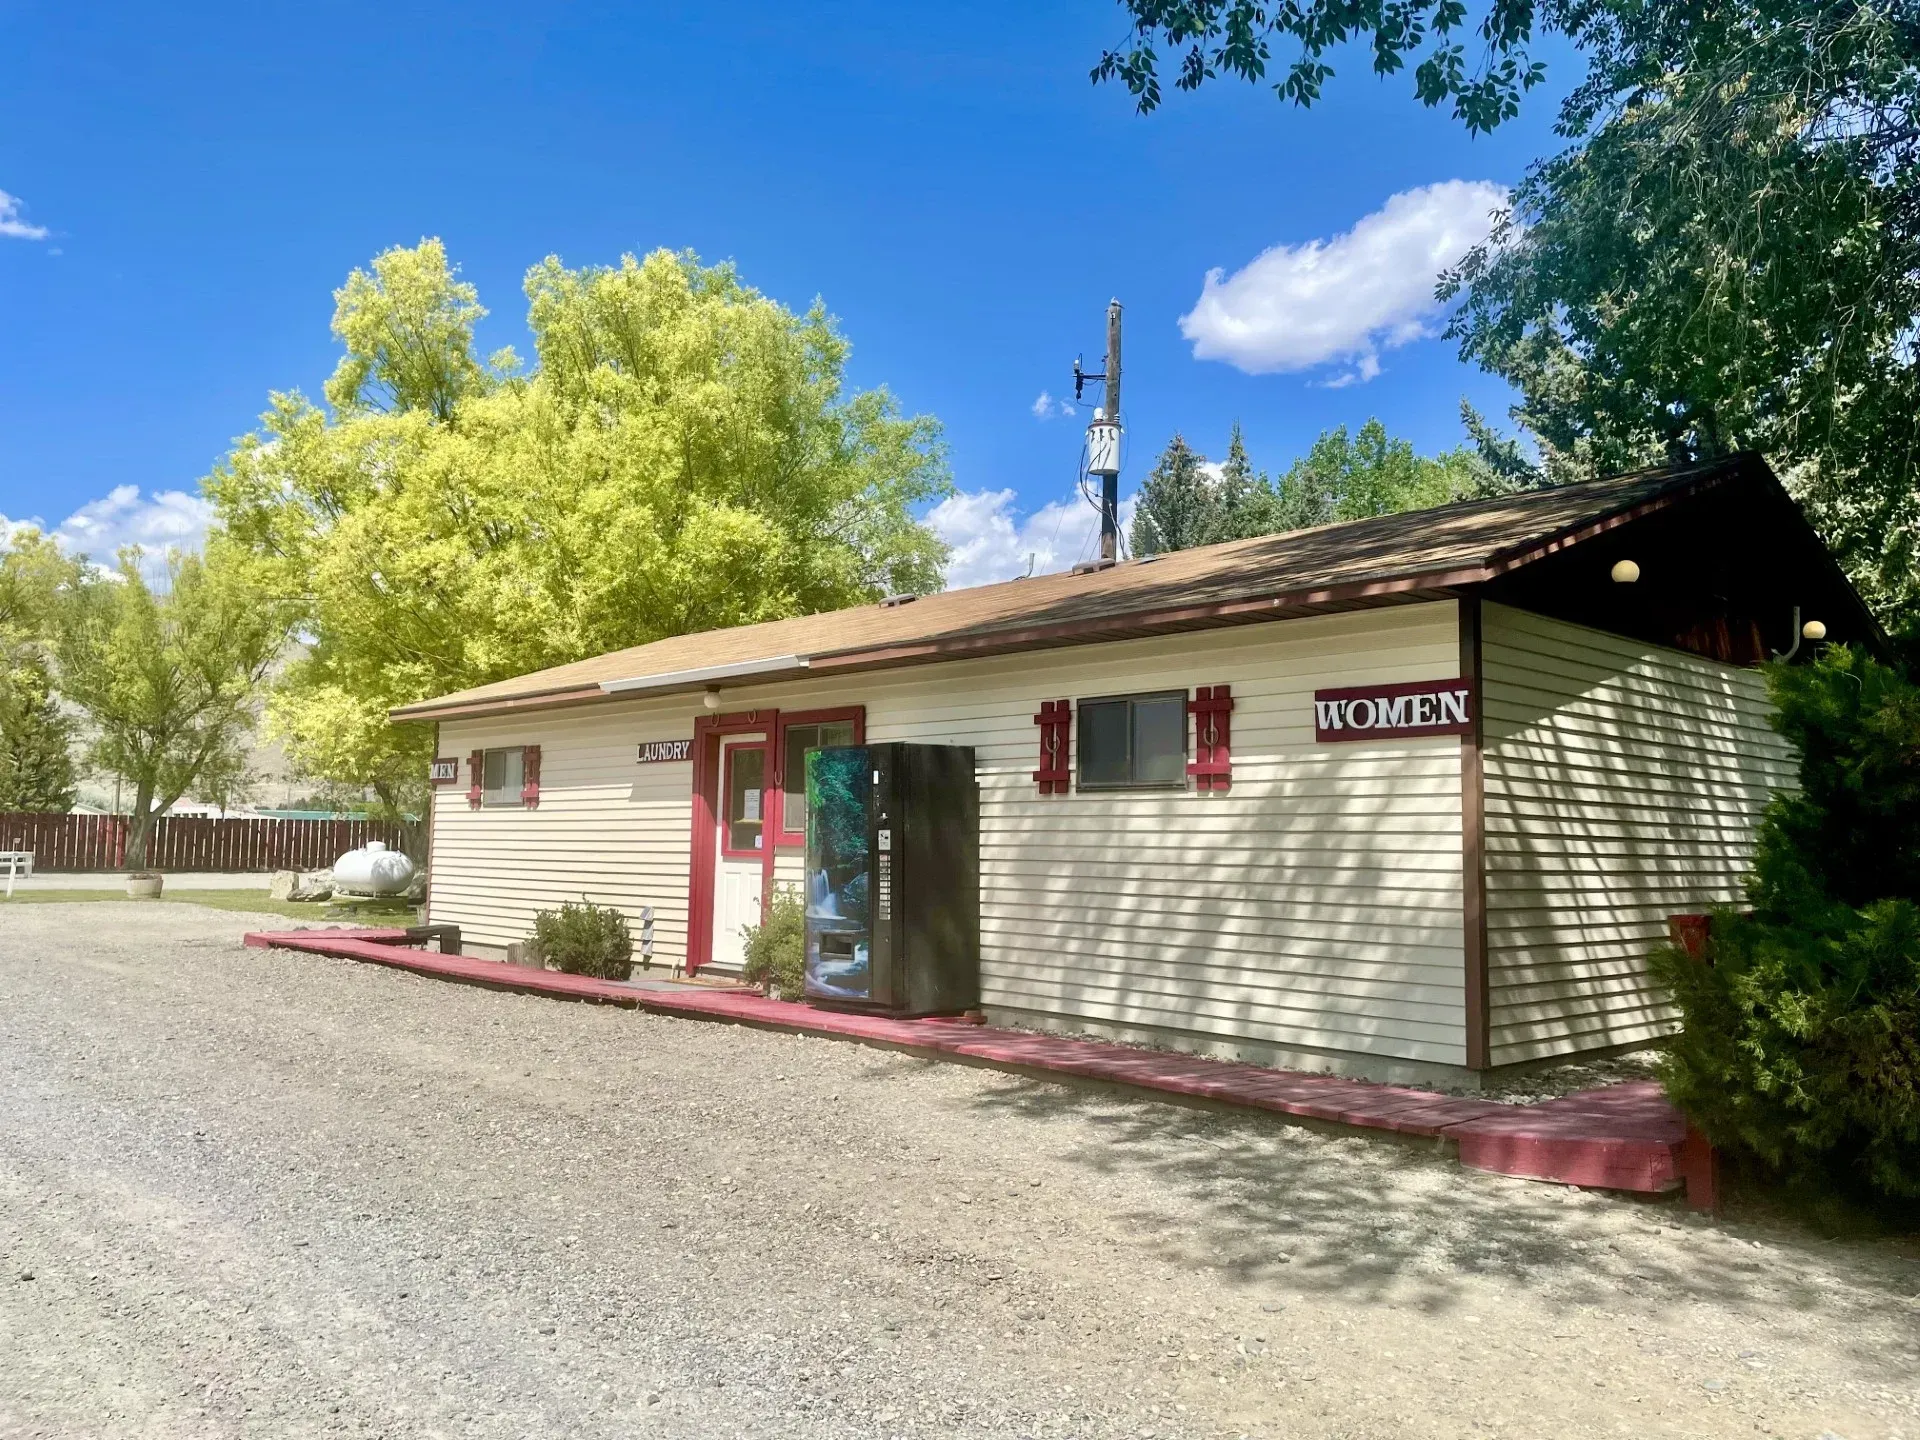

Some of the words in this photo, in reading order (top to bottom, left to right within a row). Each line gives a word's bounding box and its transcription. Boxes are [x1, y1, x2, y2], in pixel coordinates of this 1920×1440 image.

[1315, 690, 1470, 730] WOMEN
[636, 741, 690, 762] LAUNDRY
[429, 762, 456, 780] MEN
